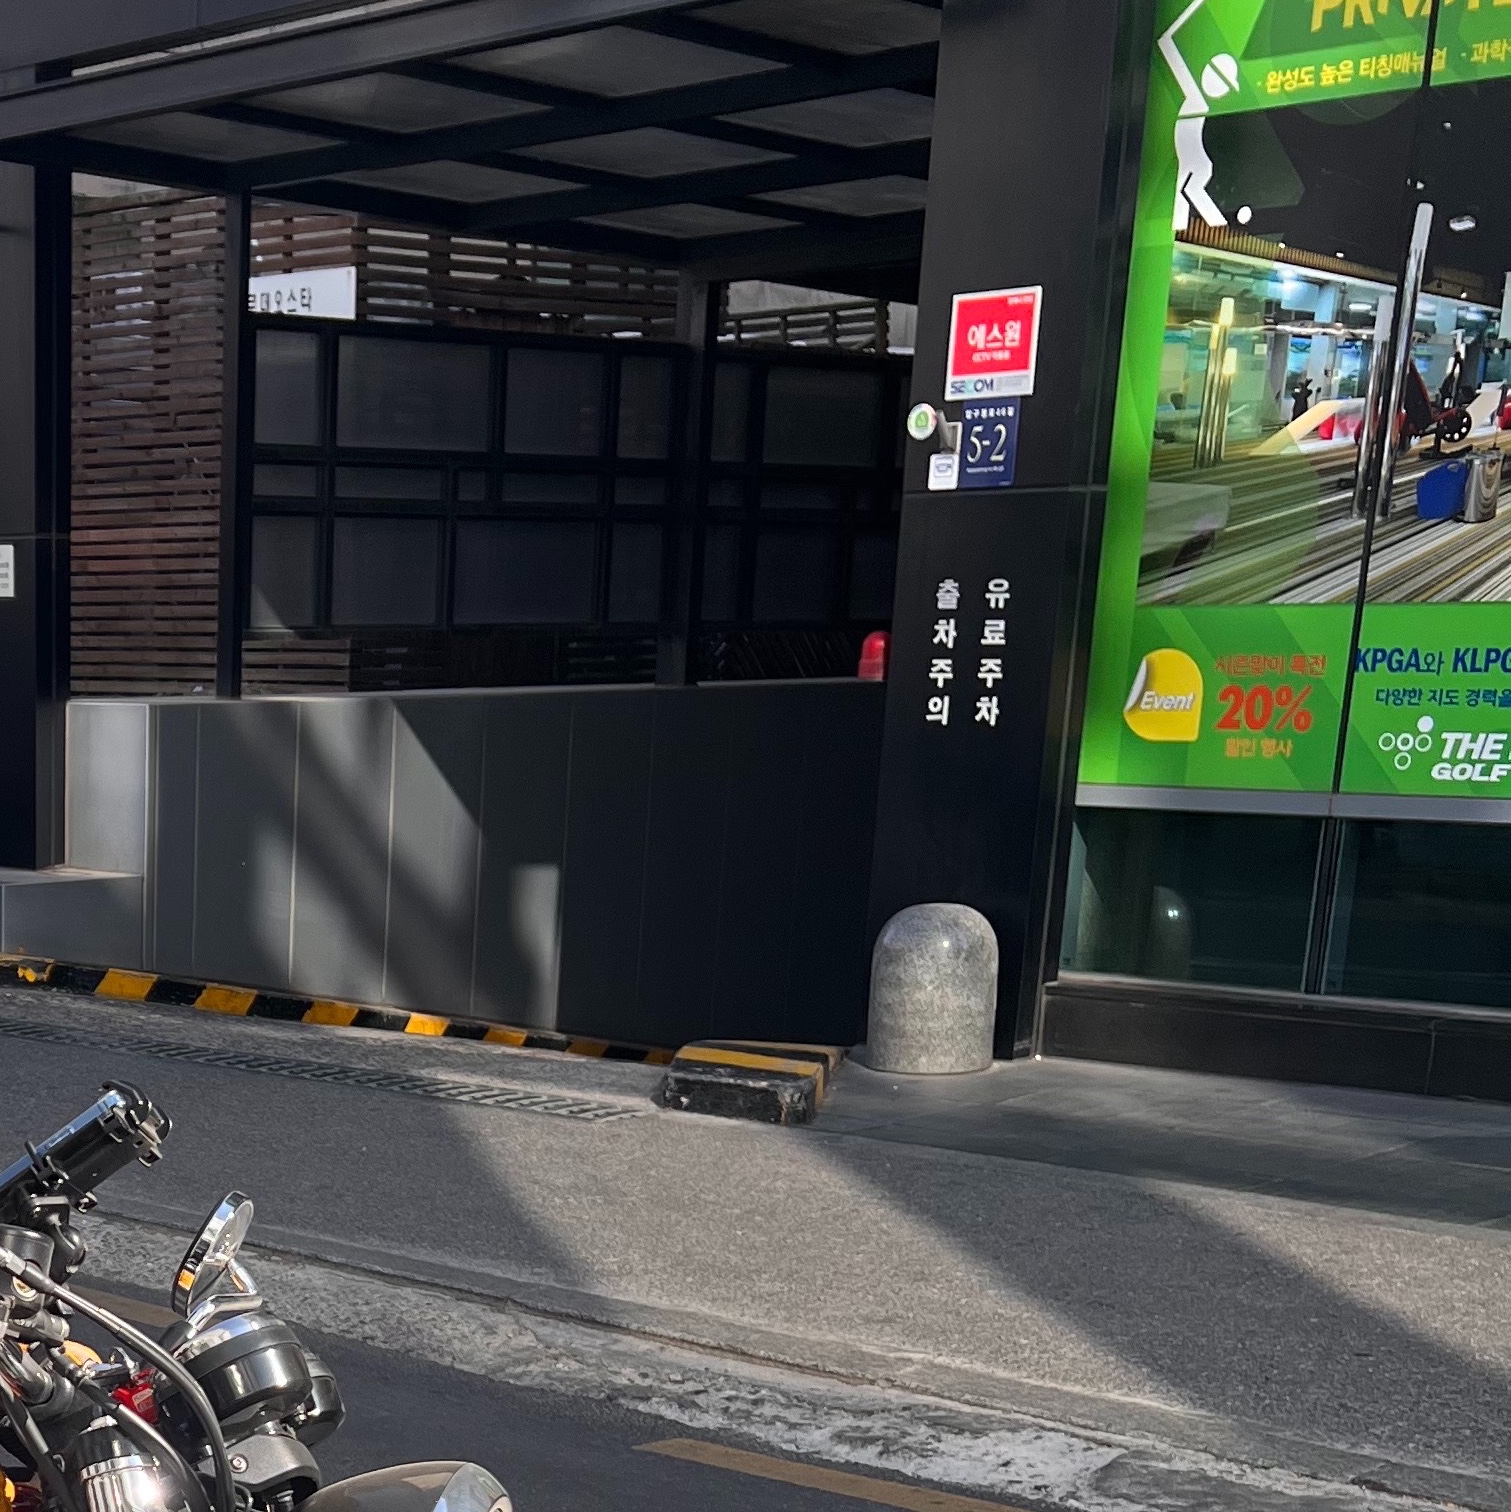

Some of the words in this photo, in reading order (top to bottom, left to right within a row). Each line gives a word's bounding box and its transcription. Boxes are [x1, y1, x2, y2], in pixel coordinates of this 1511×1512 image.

[1471, 38, 1511, 64] 과학
[1266, 64, 1315, 94] 완성도
[1319, 59, 1354, 87] 높은
[967, 320, 1022, 350] 에스원
[966, 423, 1007, 464] 5-2
[925, 578, 961, 726] 출차주의
[974, 578, 1011, 727] 유료주차
[1355, 647, 1445, 676] KPGA와
[1141, 691, 1196, 711] Event
[1215, 684, 1314, 733] 20%
[1375, 688, 1423, 707] 다양한
[1427, 688, 1460, 706] 지도
[1441, 732, 1508, 761] THE
[1431, 762, 1511, 782] GOLF
